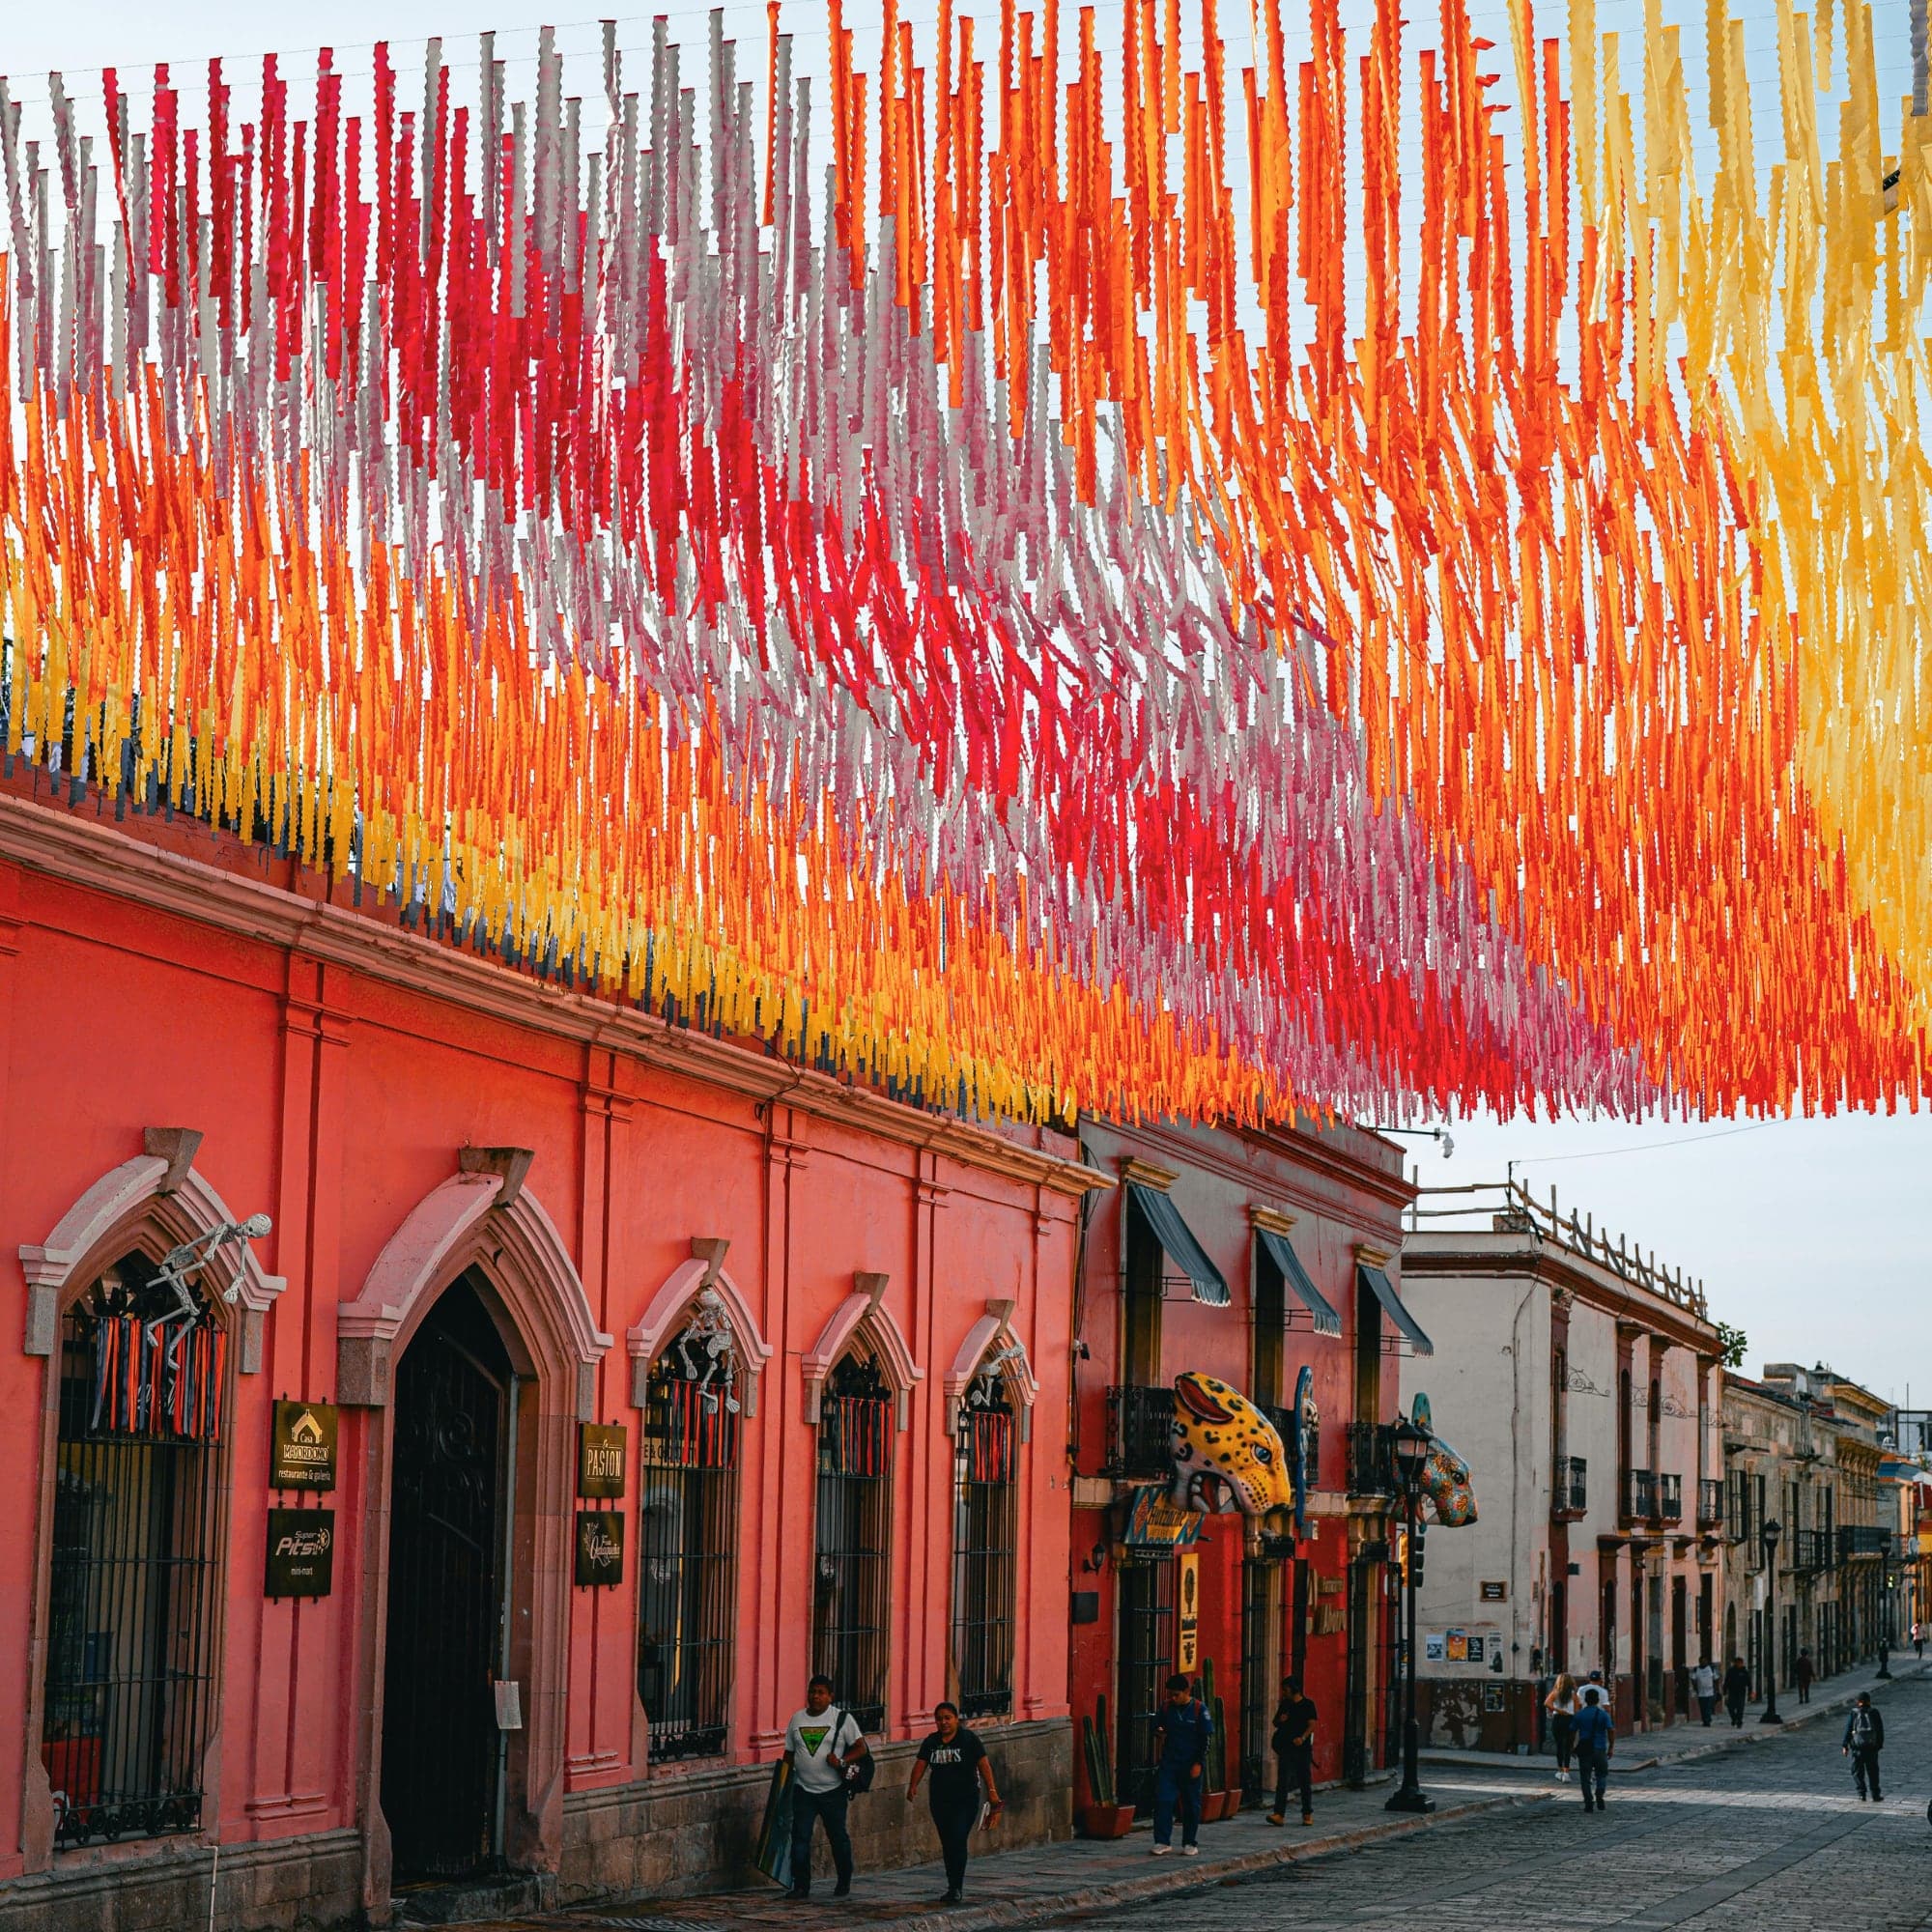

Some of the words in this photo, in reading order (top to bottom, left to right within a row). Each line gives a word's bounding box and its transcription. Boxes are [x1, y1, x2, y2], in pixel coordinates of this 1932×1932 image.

[299, 1433, 313, 1443] Casa
[283, 1444, 328, 1461] MAYORDOMO
[586, 1449, 621, 1477] PASION
[278, 1469, 308, 1480] restaurante
